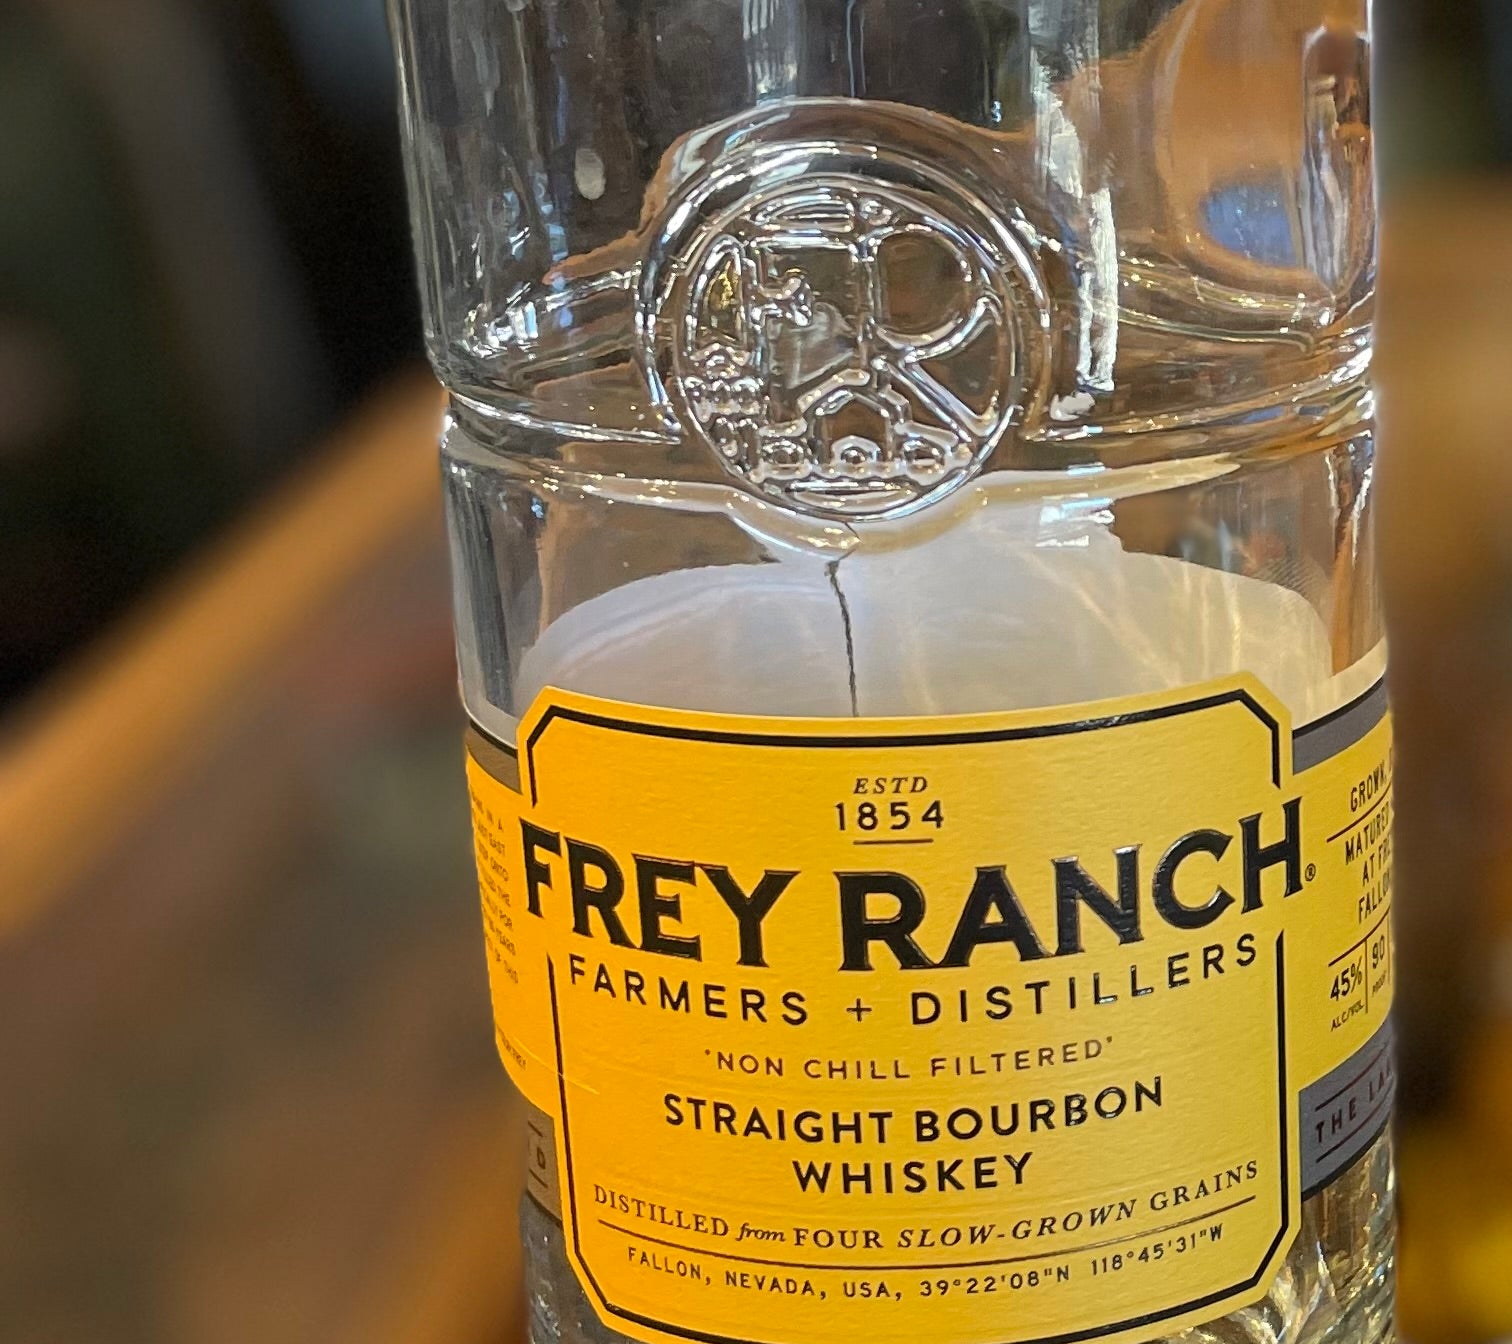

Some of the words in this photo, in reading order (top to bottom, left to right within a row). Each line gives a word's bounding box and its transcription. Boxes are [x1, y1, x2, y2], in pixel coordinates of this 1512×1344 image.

[853, 776, 928, 795] ESTD
[835, 799, 944, 830] 1854
[518, 816, 801, 968] FREY
[1363, 852, 1375, 886] AT
[1372, 935, 1384, 969] 90
[569, 953, 808, 1026] FARMERS
[912, 933, 1257, 1027] DISTILLERS
[1330, 955, 1362, 1002] 45%
[804, 1059, 910, 1079] CHILL
[664, 1093, 893, 1143] STRAIGHT
[915, 1076, 1162, 1142] BOURBON
[1315, 1097, 1357, 1144] THE
[792, 1151, 1033, 1194] WHISKEY
[594, 1184, 730, 1238] DISTILLED
[735, 1222, 786, 1242] from
[794, 1228, 884, 1248] FOUR
[897, 1199, 1137, 1248] SLOW-GROWN
[1149, 1160, 1258, 1211] GRAINS
[628, 1246, 712, 1286] FALLON,
[725, 1270, 827, 1301] NEVADA,
[843, 1281, 903, 1301] USA,
